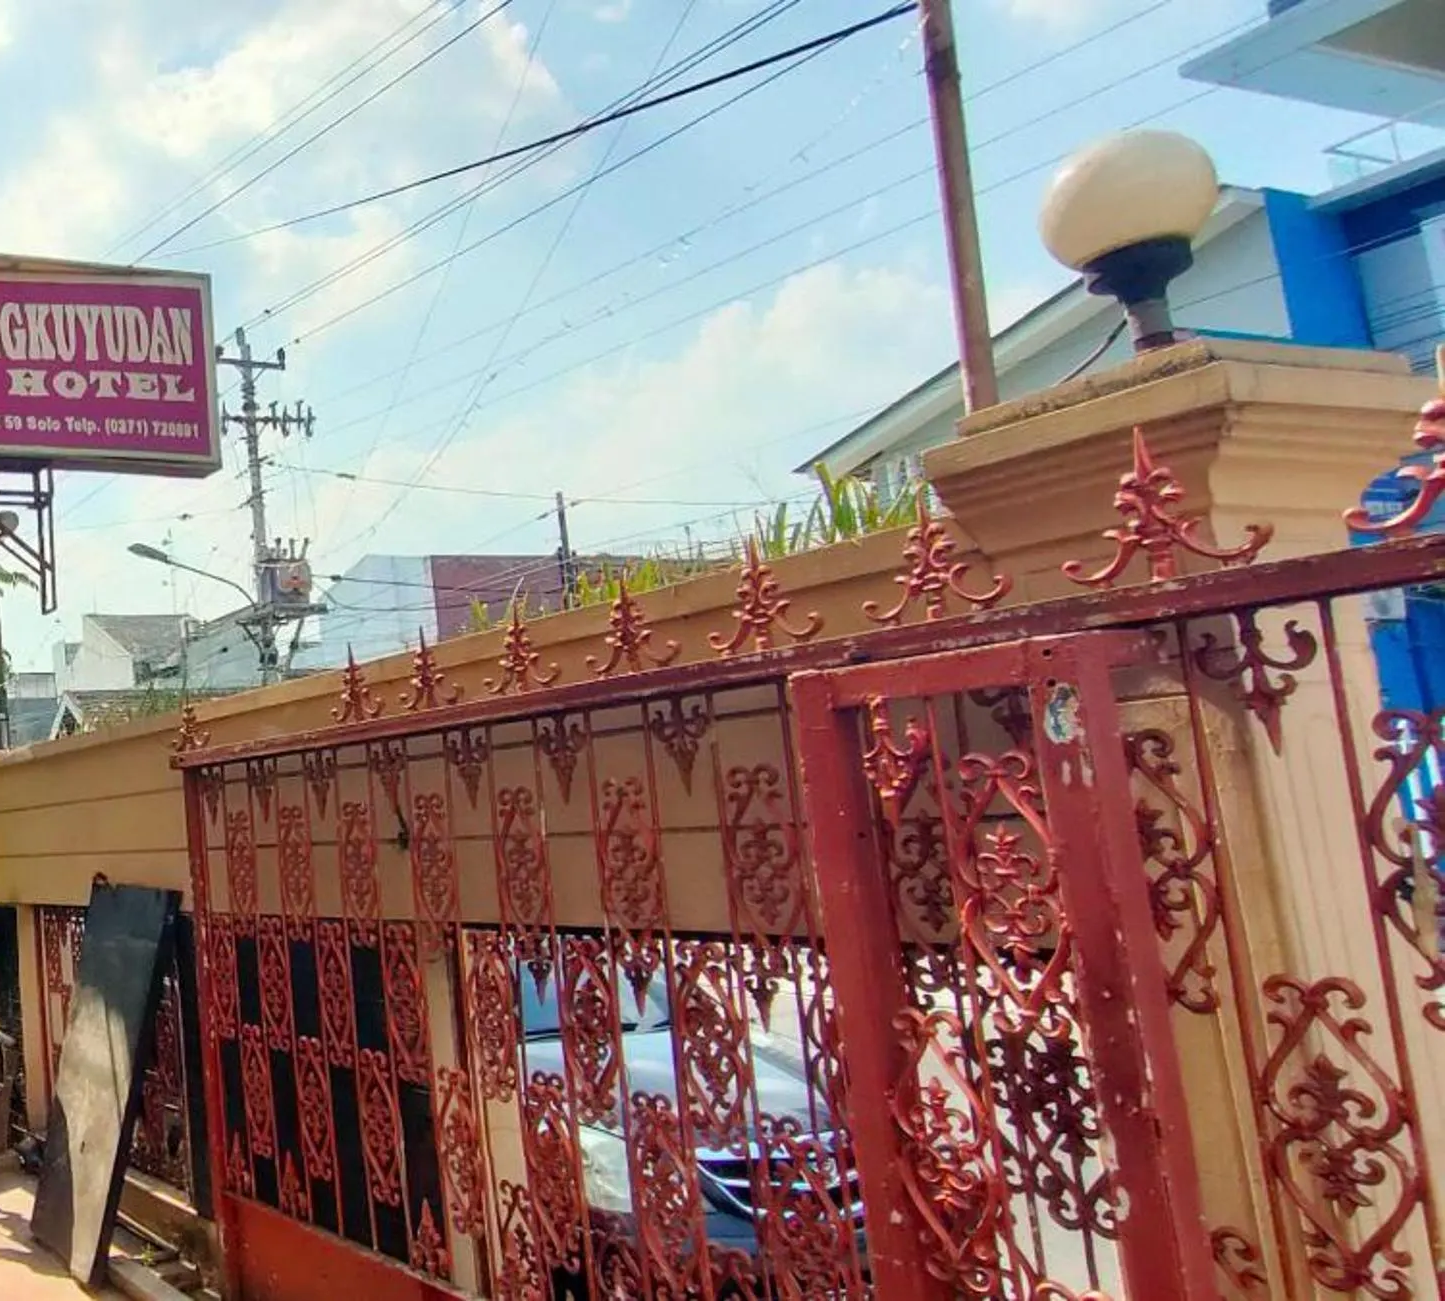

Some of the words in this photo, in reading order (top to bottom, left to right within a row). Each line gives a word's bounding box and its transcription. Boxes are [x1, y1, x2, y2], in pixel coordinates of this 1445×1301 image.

[7, 369, 195, 402] HOTEL
[5, 415, 22, 430] 59
[26, 415, 61, 431] Solo
[64, 416, 101, 436] Telp.
